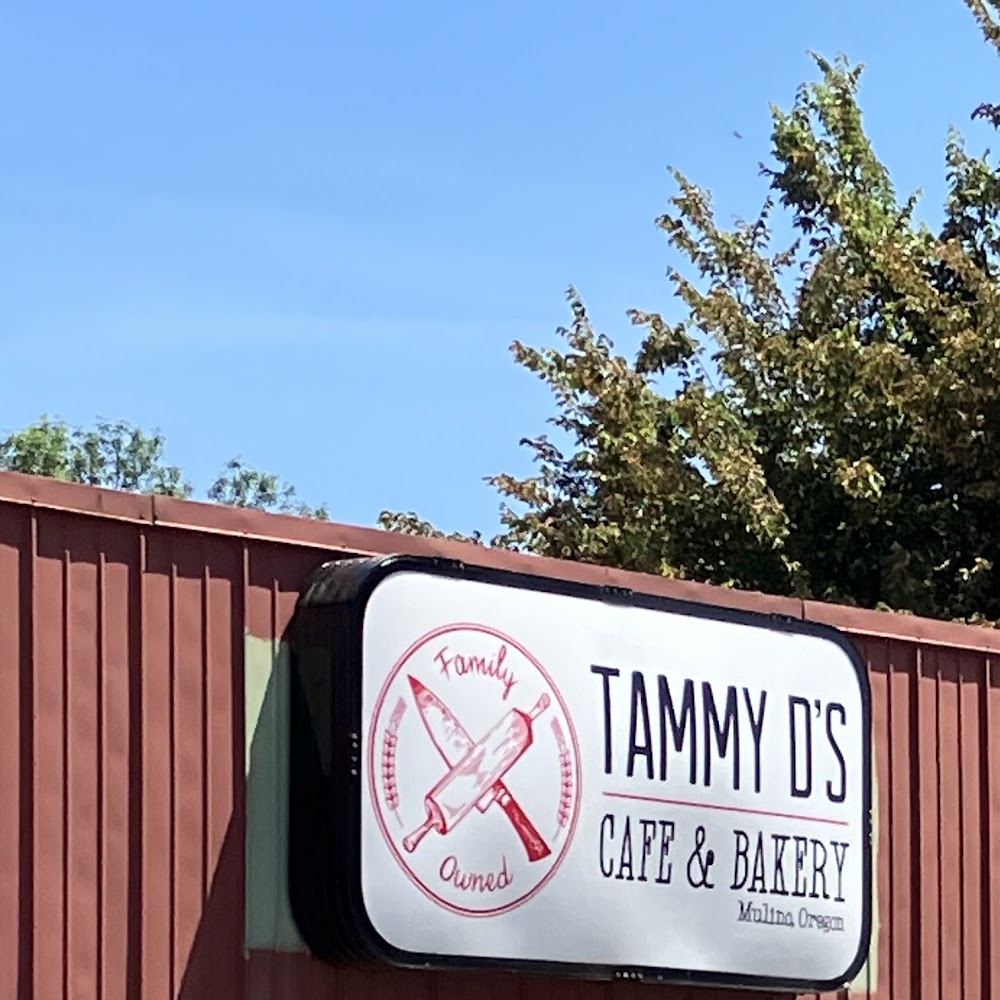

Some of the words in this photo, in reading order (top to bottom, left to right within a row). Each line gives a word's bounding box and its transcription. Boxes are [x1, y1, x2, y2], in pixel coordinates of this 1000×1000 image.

[434, 645, 518, 700] Family
[590, 664, 767, 793] TAMMY
[788, 694, 847, 803] D'S
[439, 855, 514, 893] Owned
[600, 813, 675, 885] CAFE
[687, 825, 715, 890] &
[730, 830, 850, 902] BAKERY
